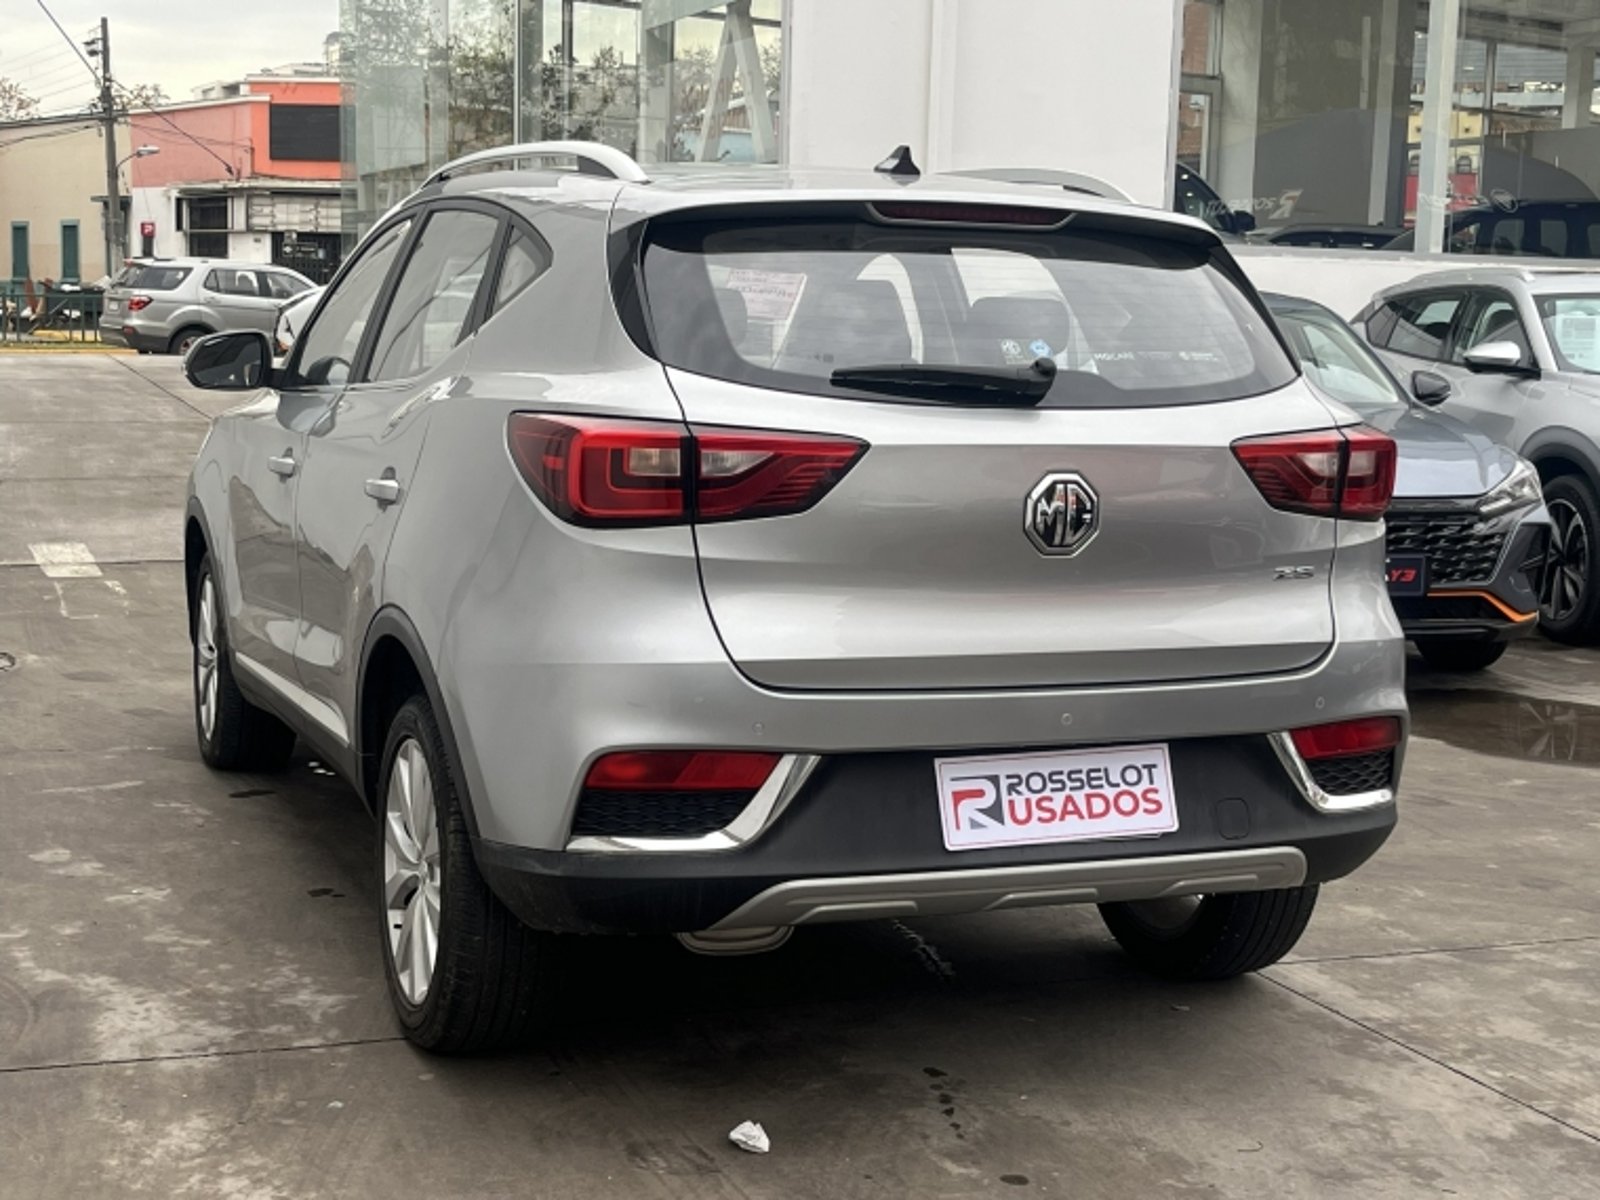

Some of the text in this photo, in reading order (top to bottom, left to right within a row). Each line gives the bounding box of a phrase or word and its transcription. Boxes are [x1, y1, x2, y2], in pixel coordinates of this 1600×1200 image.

[1033, 481, 1092, 547] MG
[1273, 565, 1314, 580] ZS
[1005, 763, 1158, 796] ROSSELOT
[1007, 787, 1163, 826] USADOS
